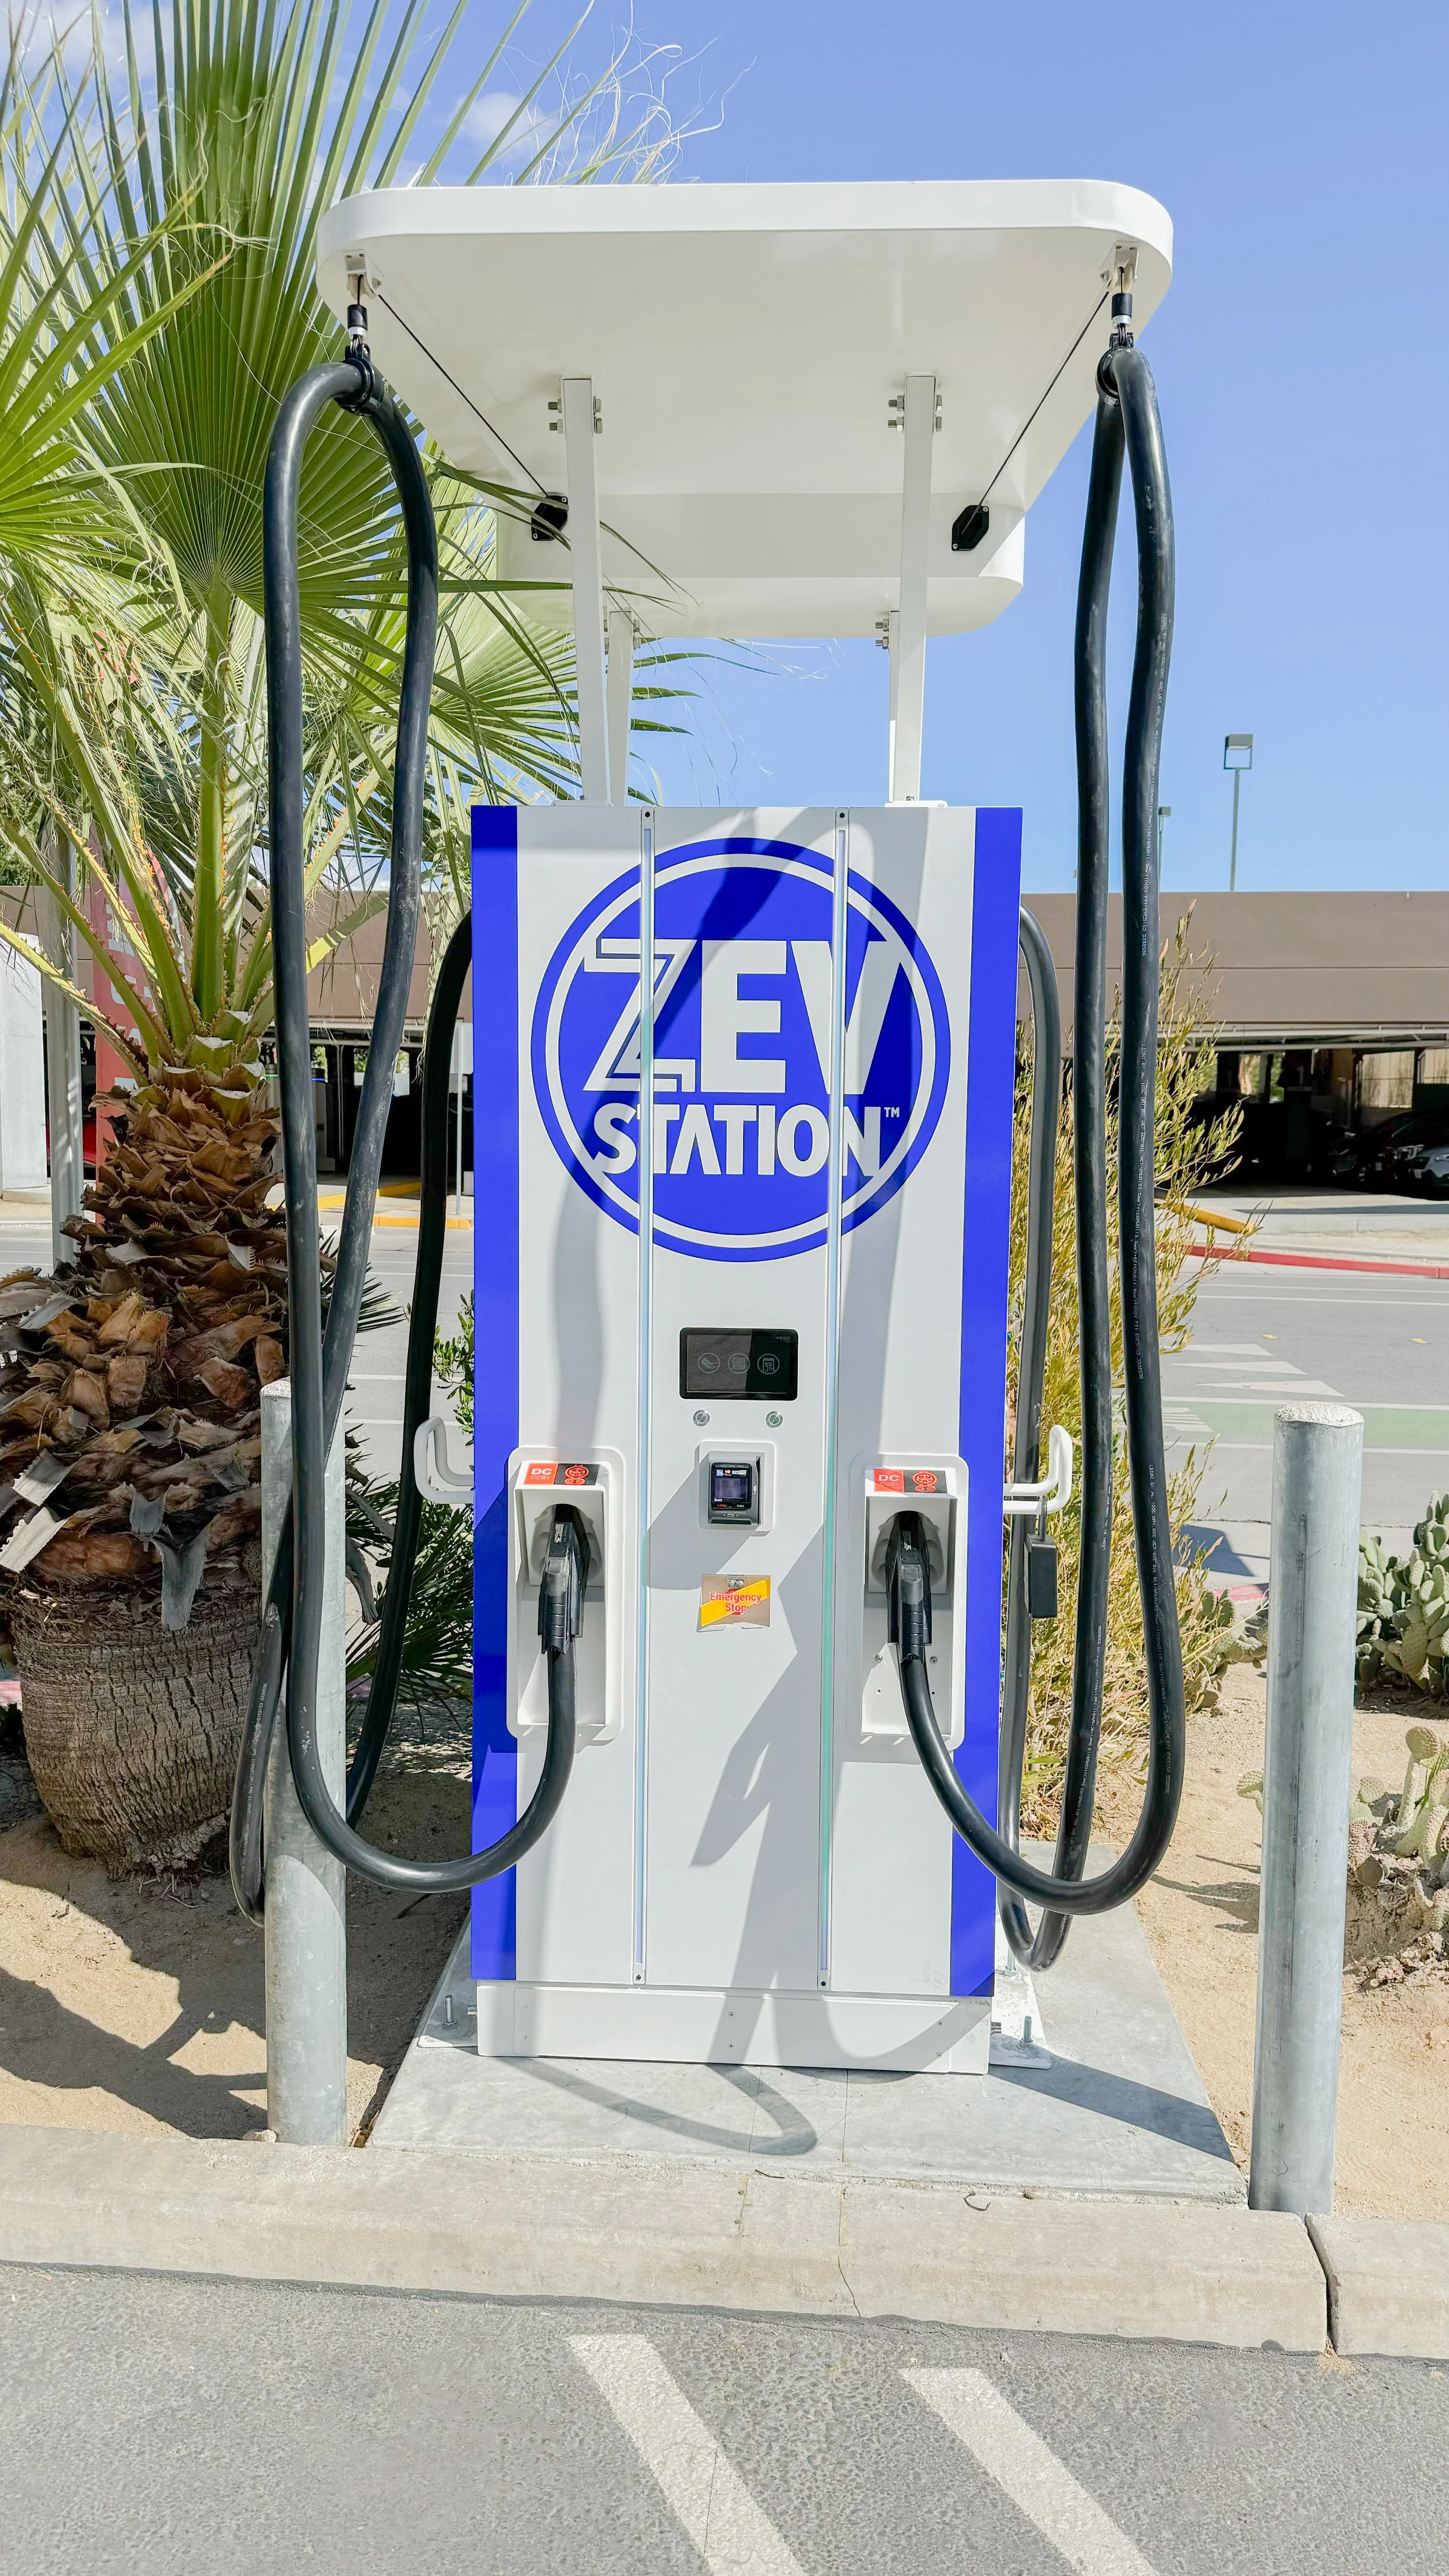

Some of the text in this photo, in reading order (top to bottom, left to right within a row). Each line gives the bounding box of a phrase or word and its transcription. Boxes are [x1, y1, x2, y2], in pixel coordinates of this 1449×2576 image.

[584, 938, 901, 1094] ZEV
[592, 1103, 880, 1177] STATION
[710, 1592, 762, 1603] Emergency
[725, 1603, 747, 1613] Stop
